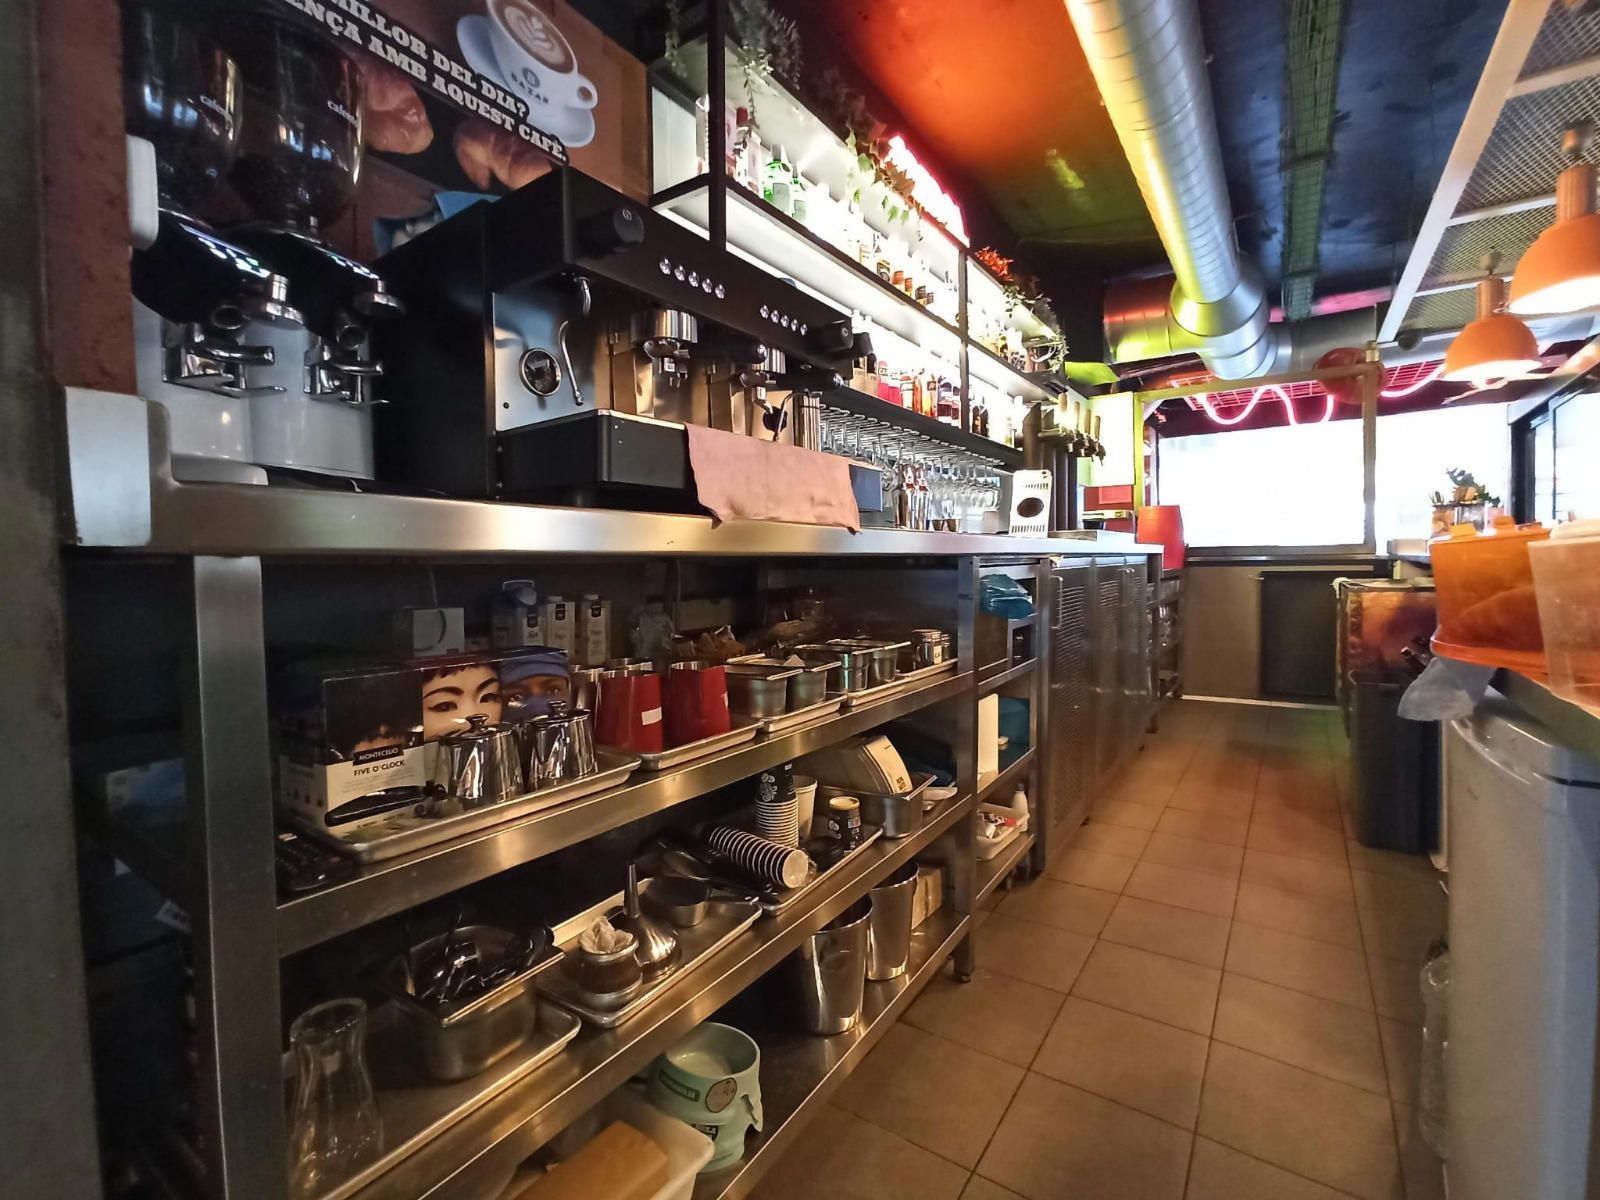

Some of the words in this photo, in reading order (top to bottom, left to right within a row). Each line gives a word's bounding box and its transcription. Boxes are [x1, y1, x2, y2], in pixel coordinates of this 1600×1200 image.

[368, 35, 428, 83] AMB
[432, 73, 515, 132] AQUEST
[432, 49, 477, 90] DEL
[481, 78, 527, 118] DIA?
[354, 767, 371, 776] FIVE
